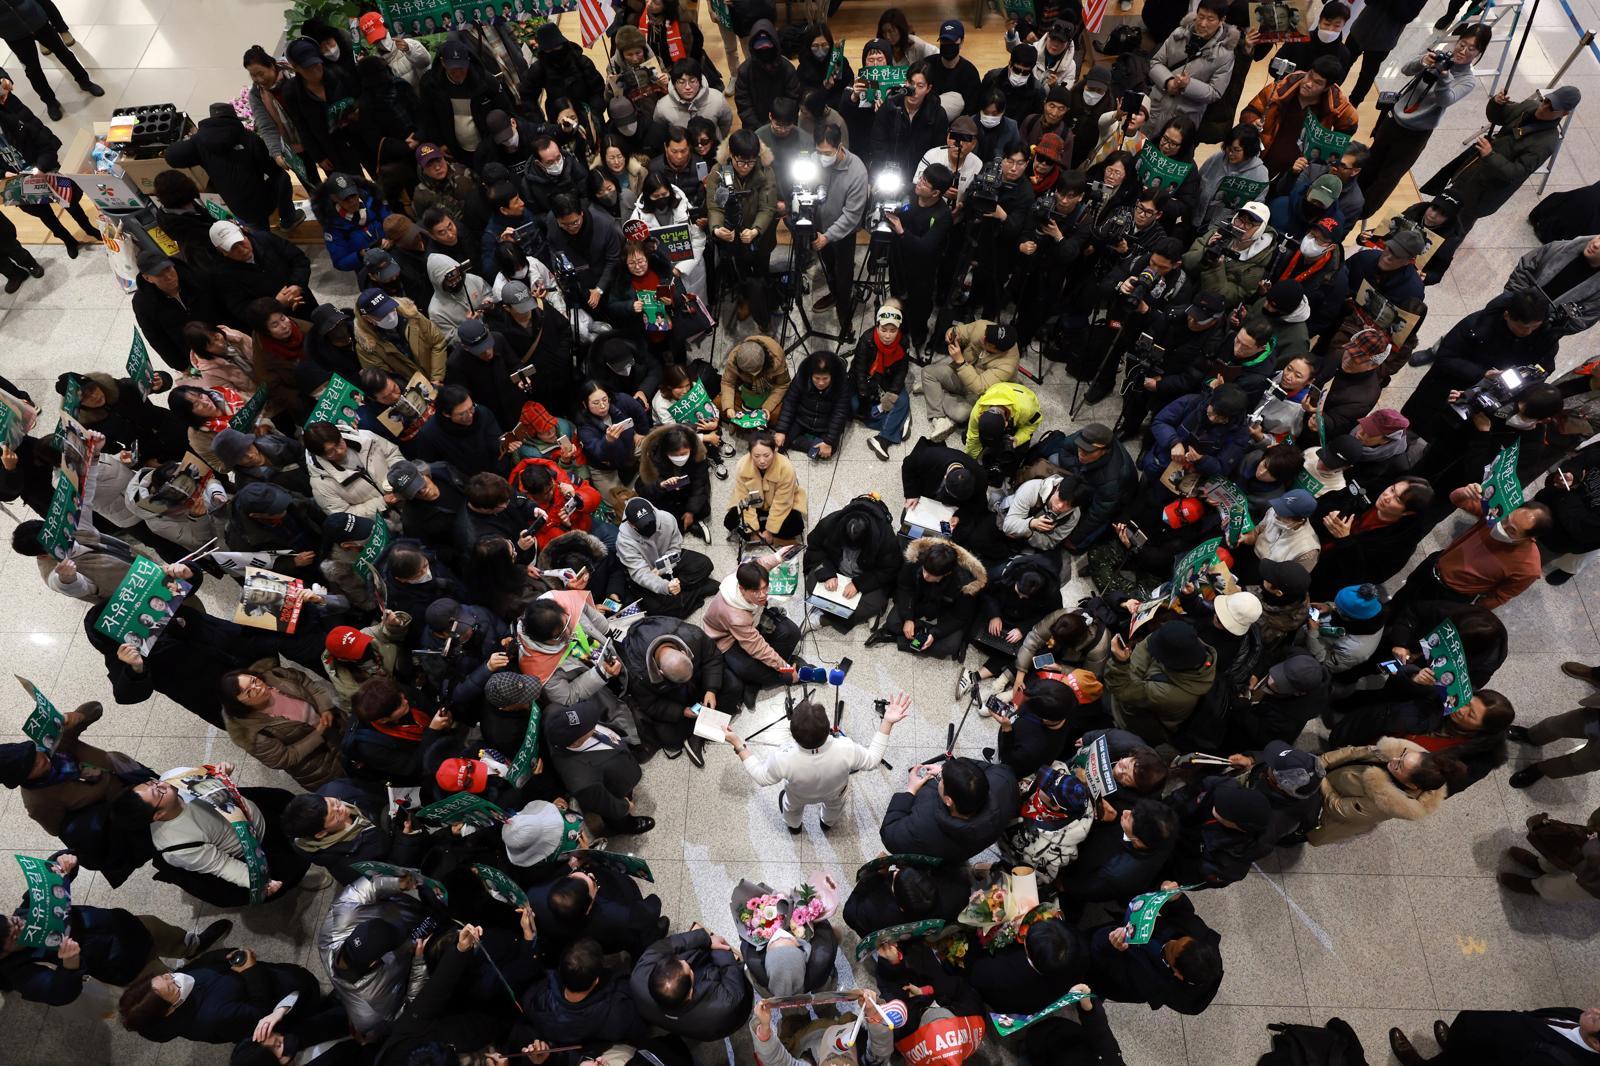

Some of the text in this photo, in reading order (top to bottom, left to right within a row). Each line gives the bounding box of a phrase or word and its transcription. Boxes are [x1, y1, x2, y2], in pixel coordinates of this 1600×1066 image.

[1144, 144, 1189, 177] 자유한길단
[632, 229, 648, 241] TV
[310, 378, 345, 425] 유한길단
[42, 475, 71, 544] 자유한길단
[102, 560, 156, 634] 자유한길단
[1443, 623, 1472, 701] 자유한길단
[20, 857, 47, 942] 자유한길단
